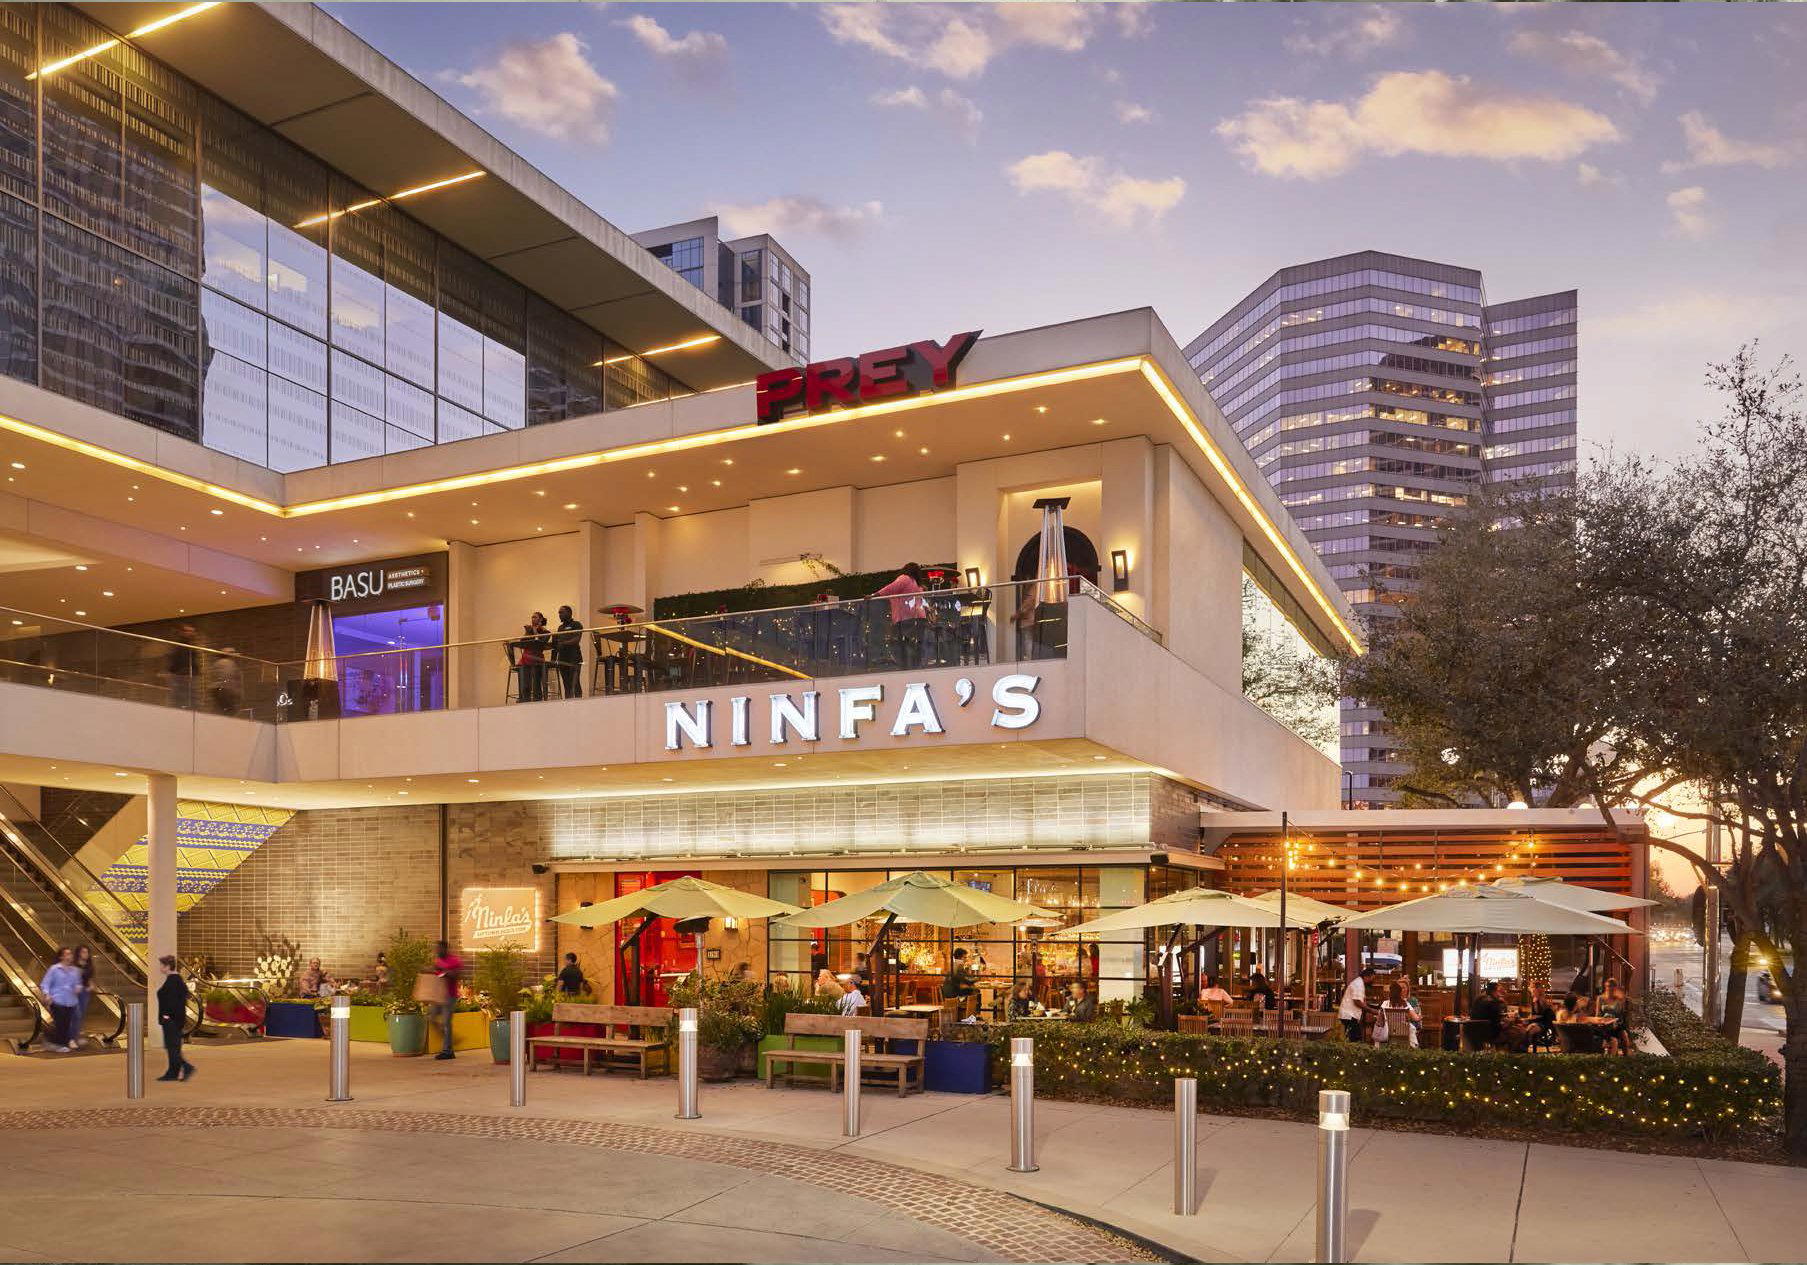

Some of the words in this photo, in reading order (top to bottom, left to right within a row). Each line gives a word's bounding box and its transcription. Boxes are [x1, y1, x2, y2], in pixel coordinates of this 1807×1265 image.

[756, 329, 982, 425] PREY
[331, 569, 384, 601] BASU
[664, 673, 1042, 750] NINFA'S
